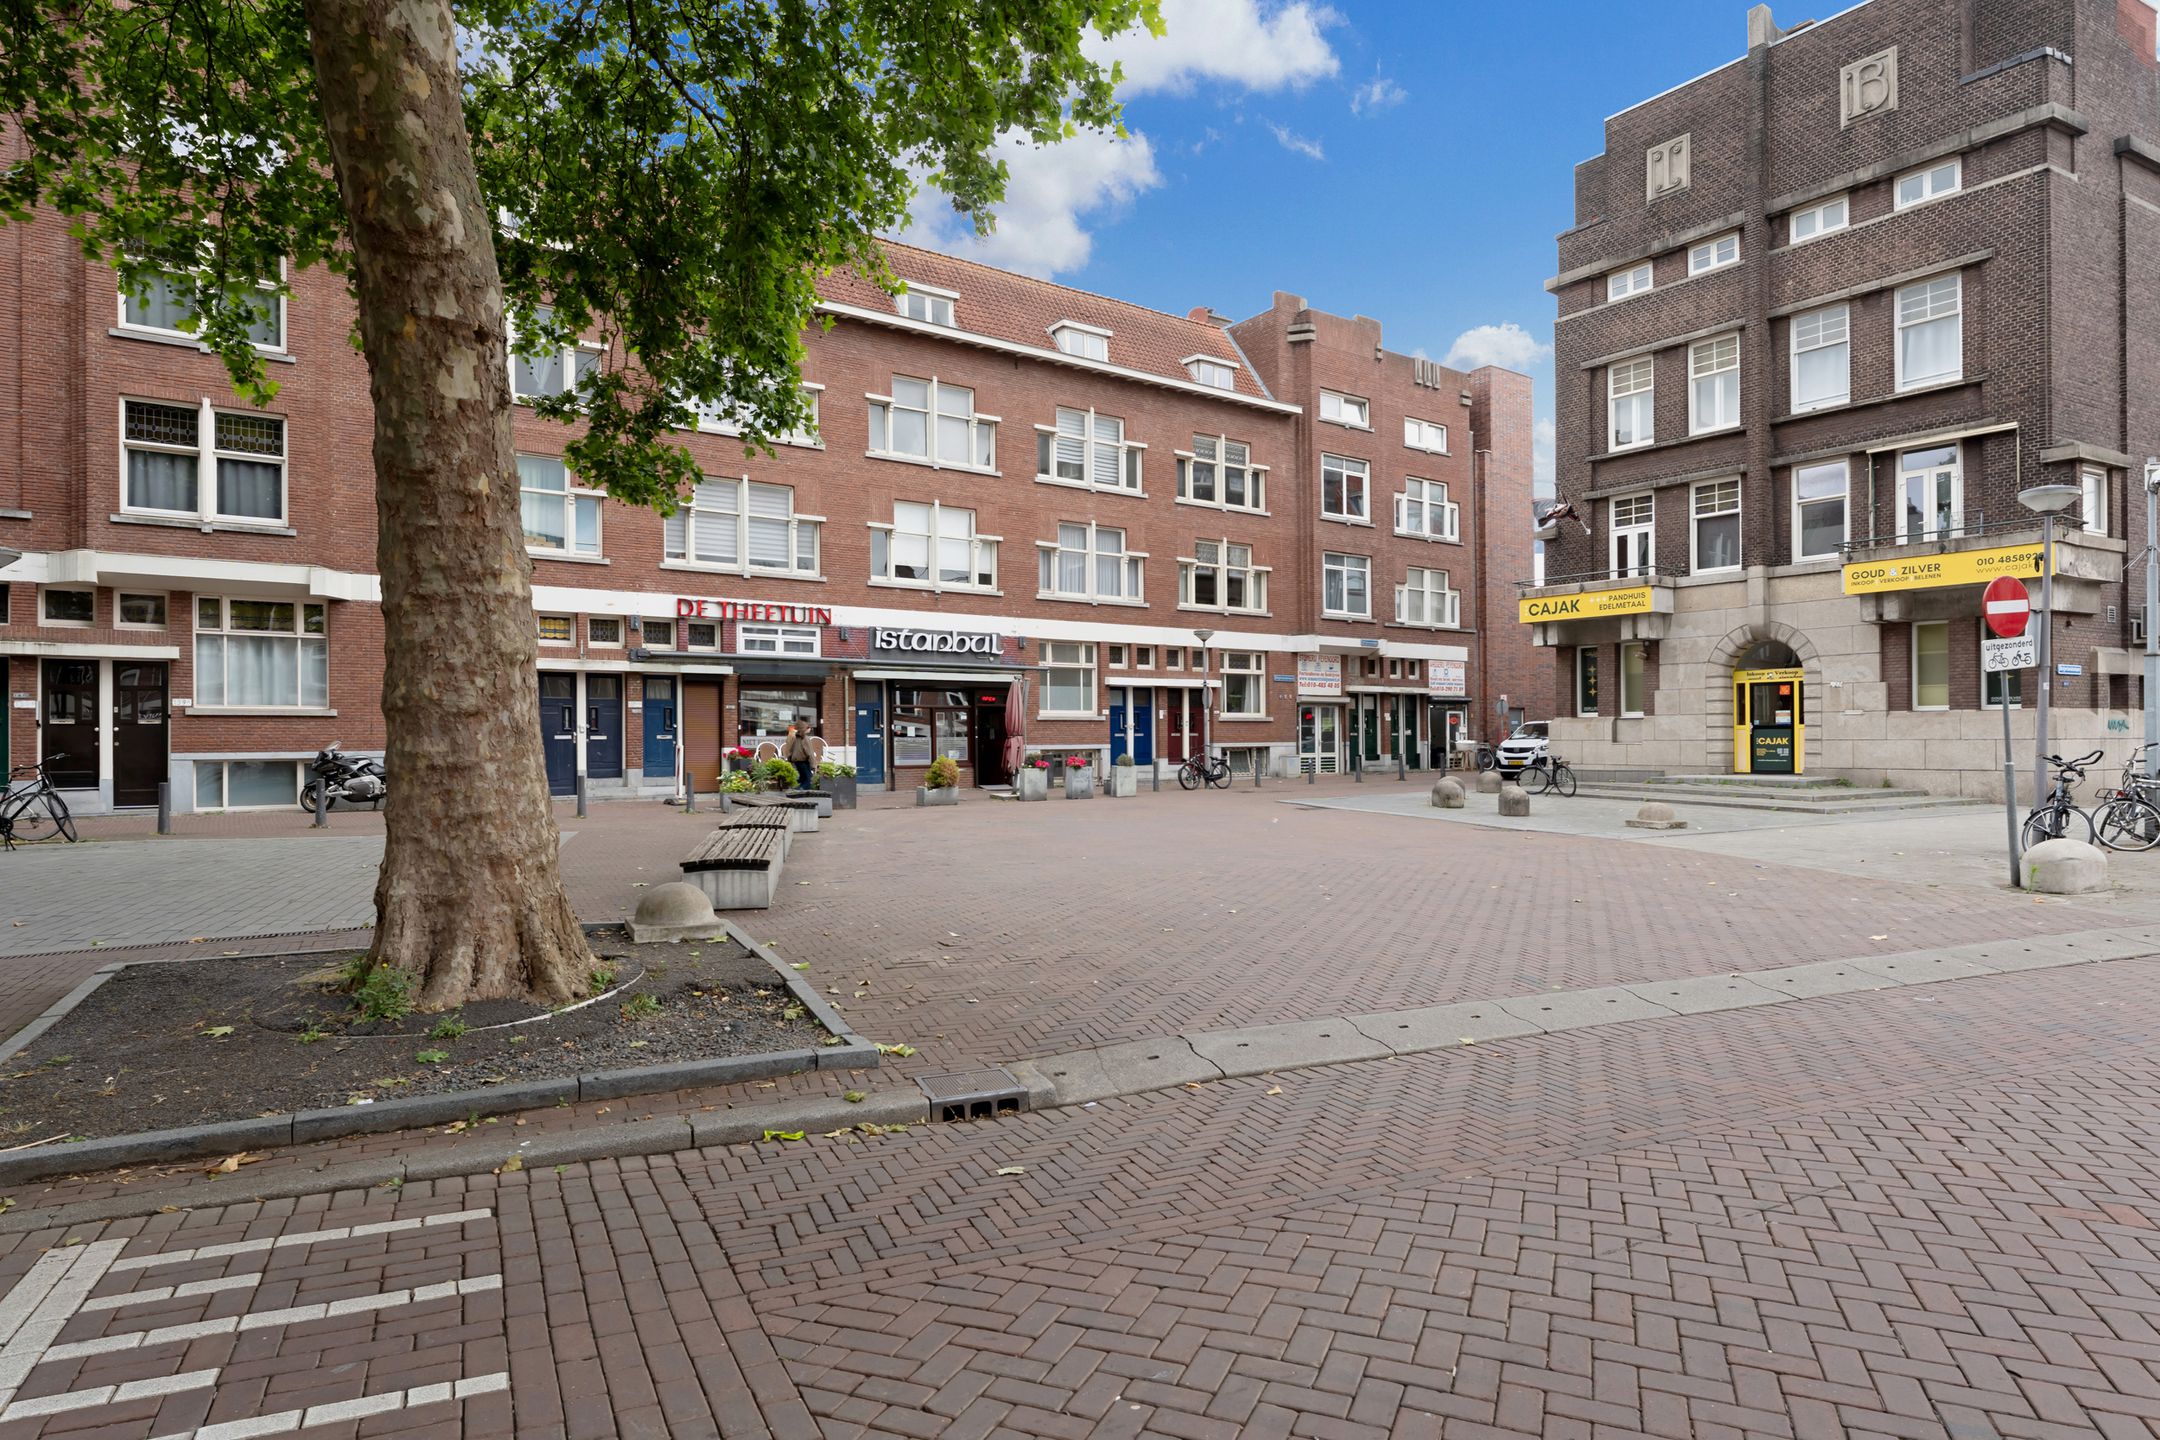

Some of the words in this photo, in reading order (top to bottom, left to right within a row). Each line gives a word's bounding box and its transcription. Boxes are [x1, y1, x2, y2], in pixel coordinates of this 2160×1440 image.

[1976, 557, 1995, 566] 010
[1851, 568, 1885, 580] GOUD
[1889, 567, 1898, 577] &
[1901, 563, 1941, 575] ZILVER
[1851, 578, 1875, 587] INKOOP
[1879, 575, 1910, 585] VERKOOP
[1914, 572, 1942, 581] BELENEN
[1608, 592, 1646, 602] PANDHUIS
[677, 597, 709, 619] DE
[720, 600, 832, 625] THEETUIN
[1528, 599, 1580, 616] CAJAK
[1599, 600, 1646, 611] EDELMETAAL
[875, 626, 1004, 655] istanbul
[1985, 639, 2033, 652] uitgezonderd
[1758, 737, 1789, 745] CAJAK
